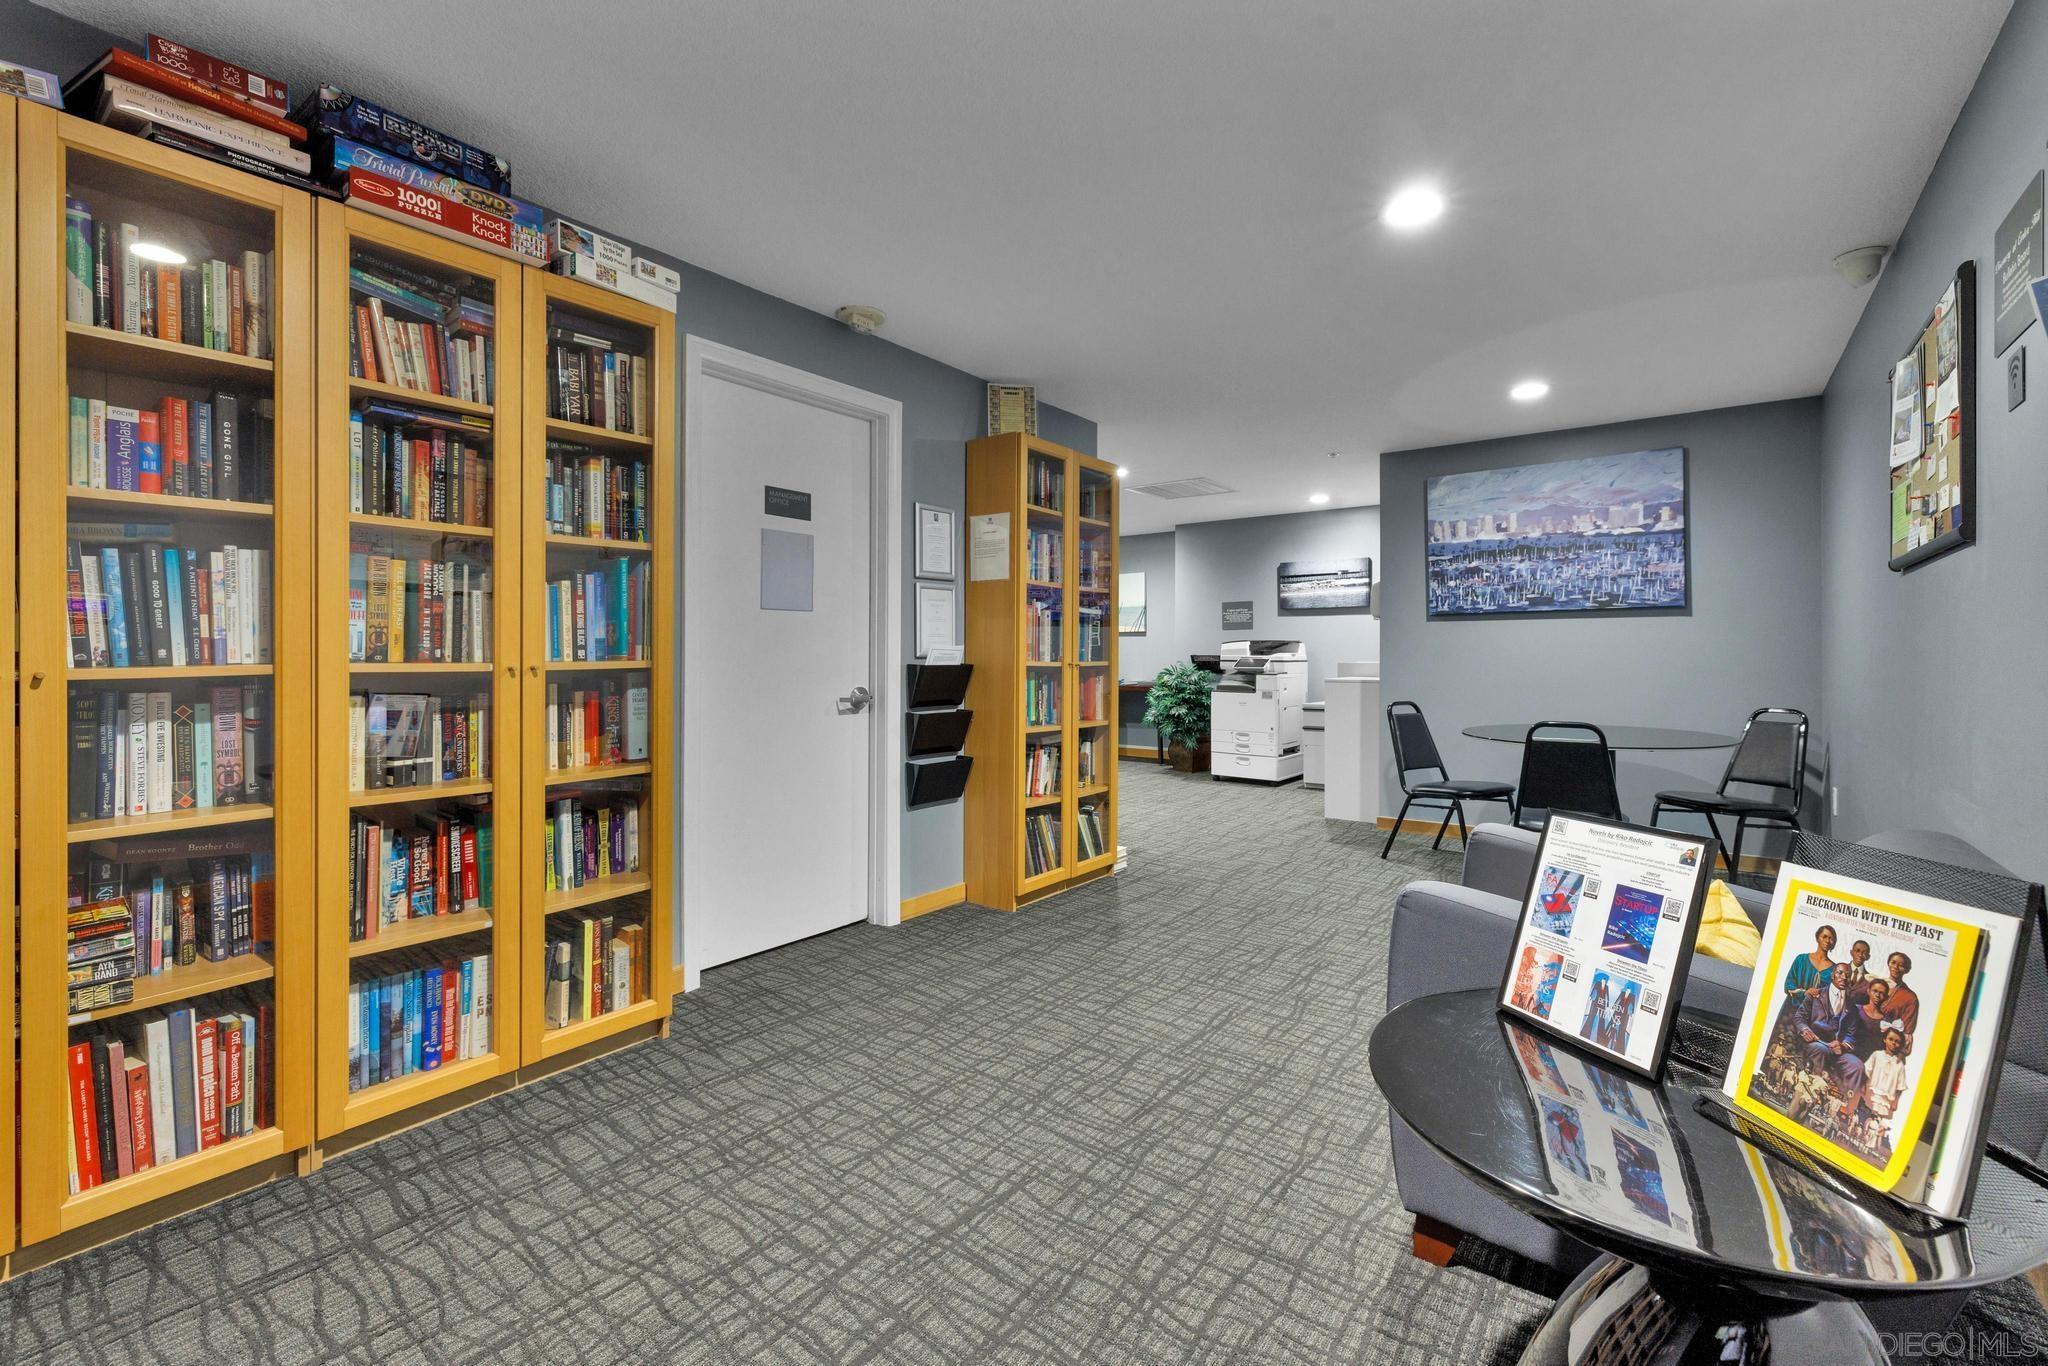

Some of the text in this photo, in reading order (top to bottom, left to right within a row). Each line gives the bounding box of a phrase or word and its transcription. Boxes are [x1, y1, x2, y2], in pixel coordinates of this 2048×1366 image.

[156, 53, 187, 72] 1000
[153, 107, 218, 134] HARMONIC
[219, 129, 286, 158] EXPERIENCE
[386, 118, 461, 156] RECORD
[226, 150, 277, 172] PHOTOGRAPHY
[352, 147, 455, 196] Trivial Pursuit
[397, 186, 437, 211] 1000
[469, 190, 507, 213] DVD
[398, 200, 442, 221] PUZZLE
[472, 212, 507, 234] Knock
[472, 224, 507, 245] Knock
[600, 252, 614, 264] 1000
[167, 291, 177, 316] SIMPLE
[127, 300, 140, 334] Warning
[167, 317, 178, 342] VICTORY
[569, 367, 581, 415] BABI YAR
[111, 409, 134, 418] POCHE
[199, 405, 208, 417] THE
[117, 421, 132, 459] Anglais
[199, 418, 208, 445] TERMINAL
[353, 432, 361, 448] LOT
[199, 446, 208, 459] LIST
[223, 421, 232, 478] GONE GIRL
[394, 470, 402, 492] SOULS
[87, 527, 123, 536] BROWN
[423, 562, 431, 580] JACK
[152, 579, 161, 598] GOOD
[189, 572, 197, 599] PATIENT
[373, 573, 387, 597] BROWN
[423, 581, 431, 600] CARR
[153, 599, 162, 608] TO
[154, 608, 164, 629] GREAT
[423, 616, 431, 627] THE
[423, 629, 431, 648] BLOOD
[576, 628, 585, 646] BLACK
[219, 706, 236, 732] BROWN
[605, 695, 620, 723] KING
[131, 696, 145, 803] MONEY STEVE FORBES
[156, 721, 165, 763] EYE INVESTING
[221, 739, 237, 749] LOST
[455, 711, 464, 773] GREAT CONTROVERSY
[216, 749, 240, 758] SYMBOL
[188, 843, 223, 852] Brother
[1588, 828, 1607, 837] Novels
[1615, 832, 1629, 841] Riko
[1629, 836, 1654, 847] Radojcic
[421, 836, 430, 882] Never Had
[450, 825, 461, 873] SMOKESCREEN
[396, 857, 405, 886] White
[413, 837, 422, 884] It So Good
[213, 871, 225, 921] AMERICAN SPY
[1616, 896, 1658, 915] STARTUP
[1805, 894, 1944, 942] RECKONING WITH THE PAST
[94, 968, 118, 980] RAND
[98, 960, 115, 970] AYN
[231, 1031, 240, 1045] Off
[200, 1037, 217, 1097] nom nom paleo
[231, 1052, 239, 1081] Beaten
[230, 1081, 240, 1101] Path
